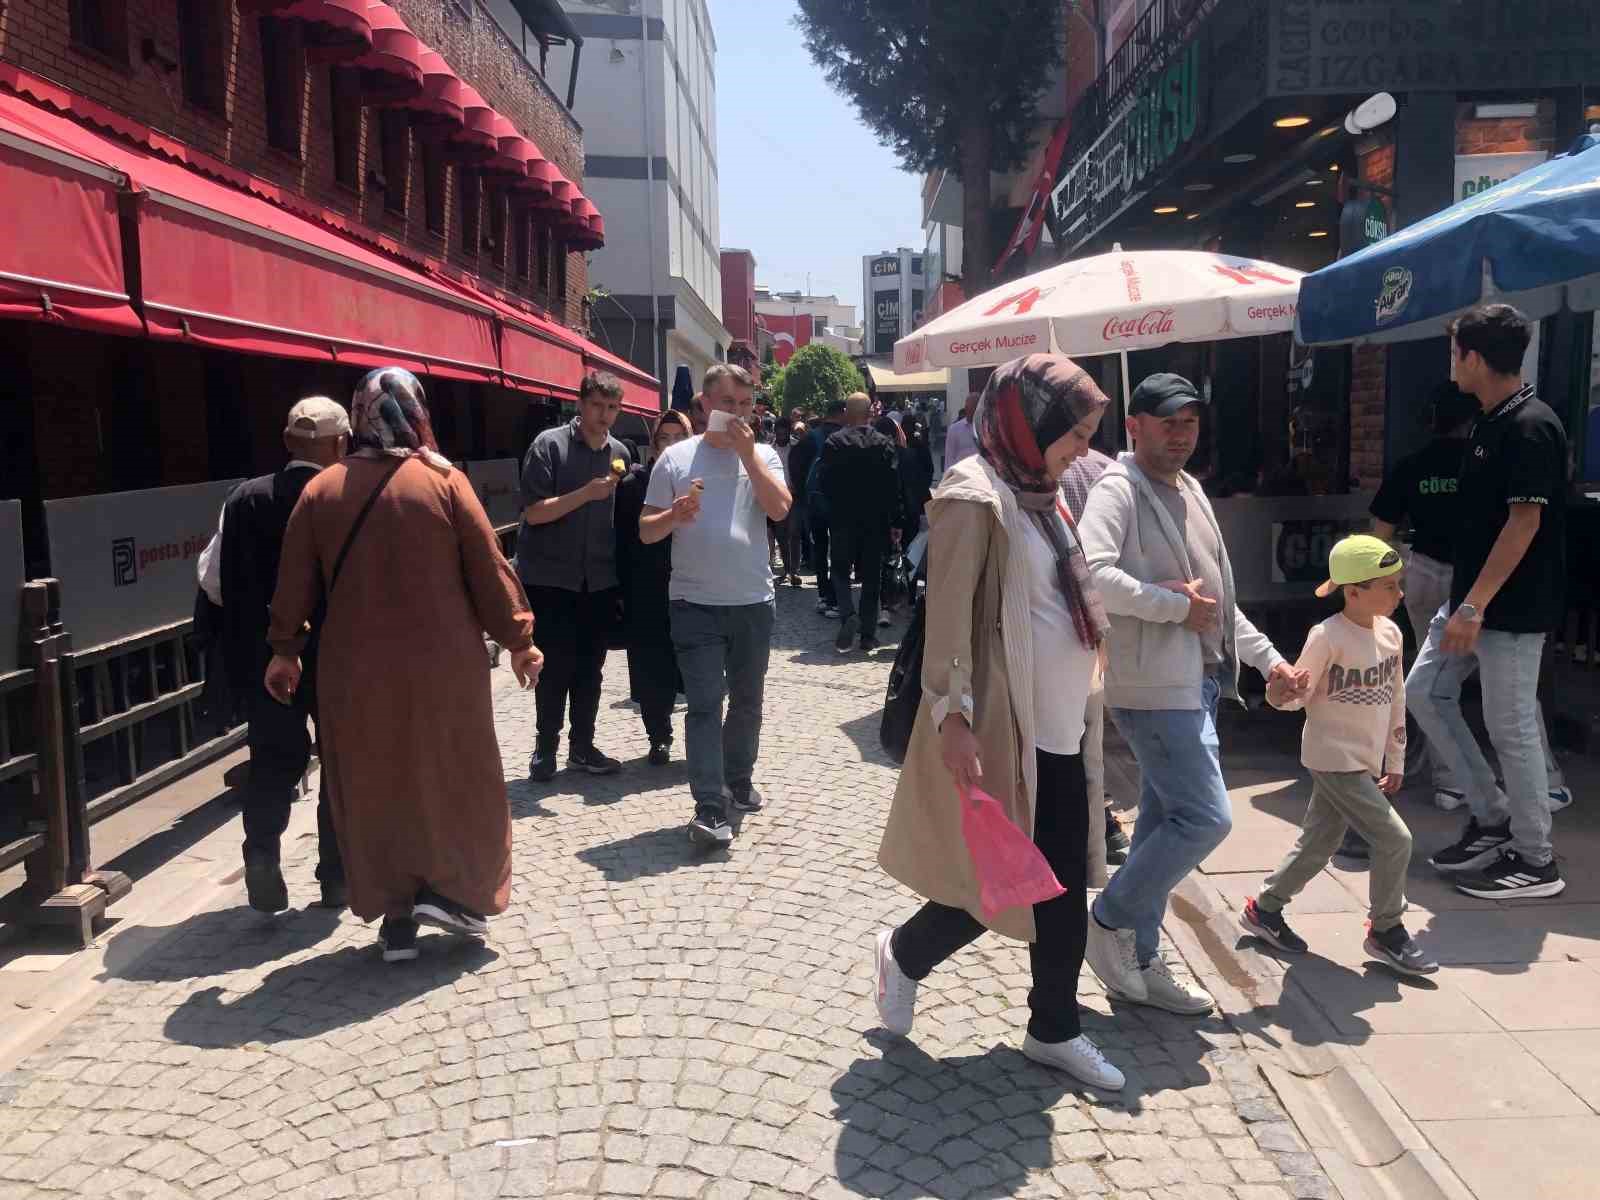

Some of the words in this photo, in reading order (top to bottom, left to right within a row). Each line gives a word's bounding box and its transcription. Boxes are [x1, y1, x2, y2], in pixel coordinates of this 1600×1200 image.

[1247, 304, 1288, 321] Gerçek
[950, 337, 992, 354] Gerçek
[996, 334, 1037, 349] Mucize
